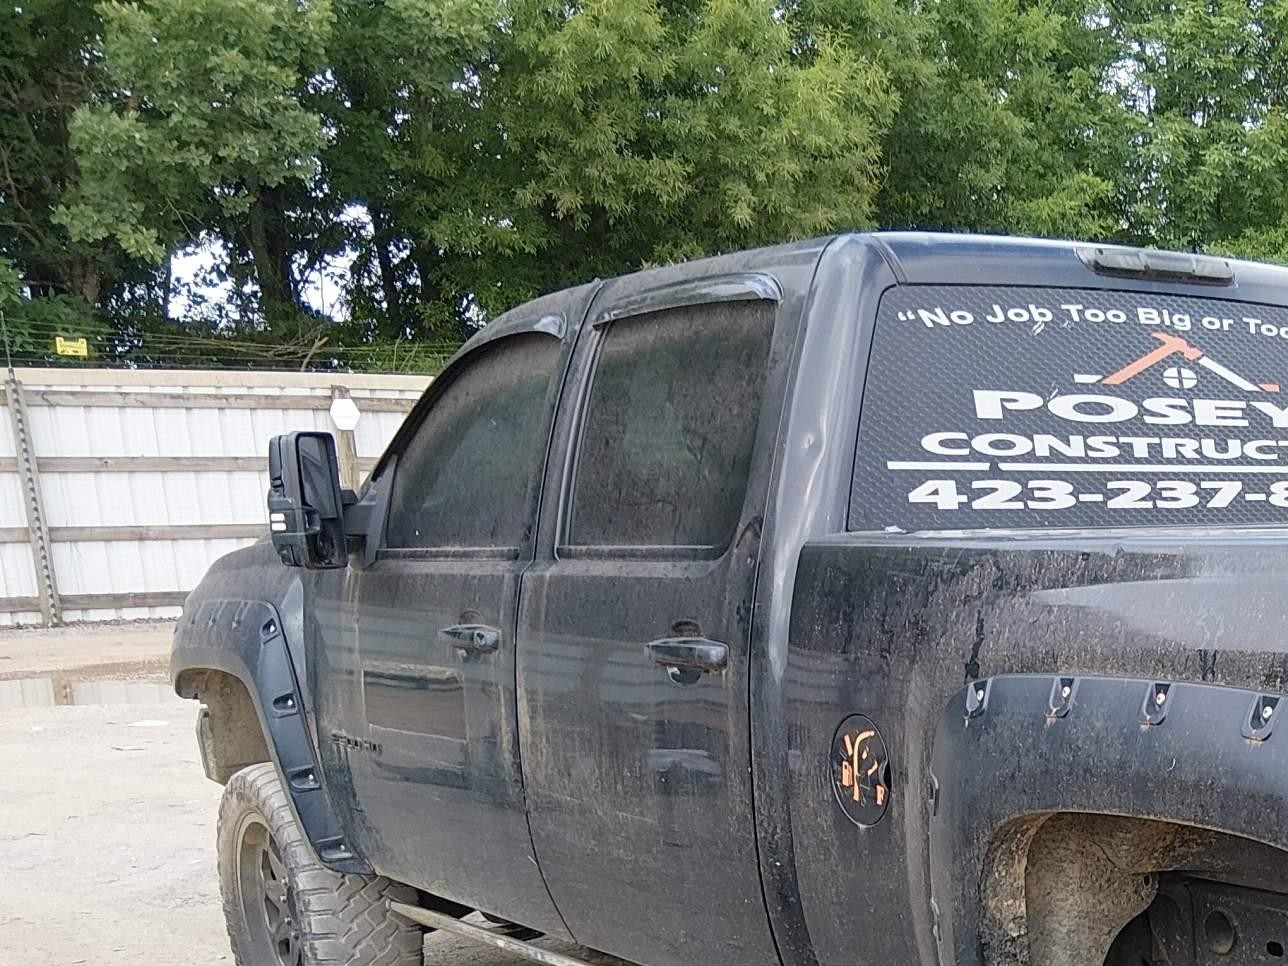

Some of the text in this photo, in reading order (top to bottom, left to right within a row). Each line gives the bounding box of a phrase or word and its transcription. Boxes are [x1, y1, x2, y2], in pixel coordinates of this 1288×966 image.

[897, 306, 975, 328] “No
[985, 303, 1054, 323] Job
[1060, 303, 1128, 324] Too
[1136, 306, 1193, 331] Big
[1201, 315, 1234, 331] or
